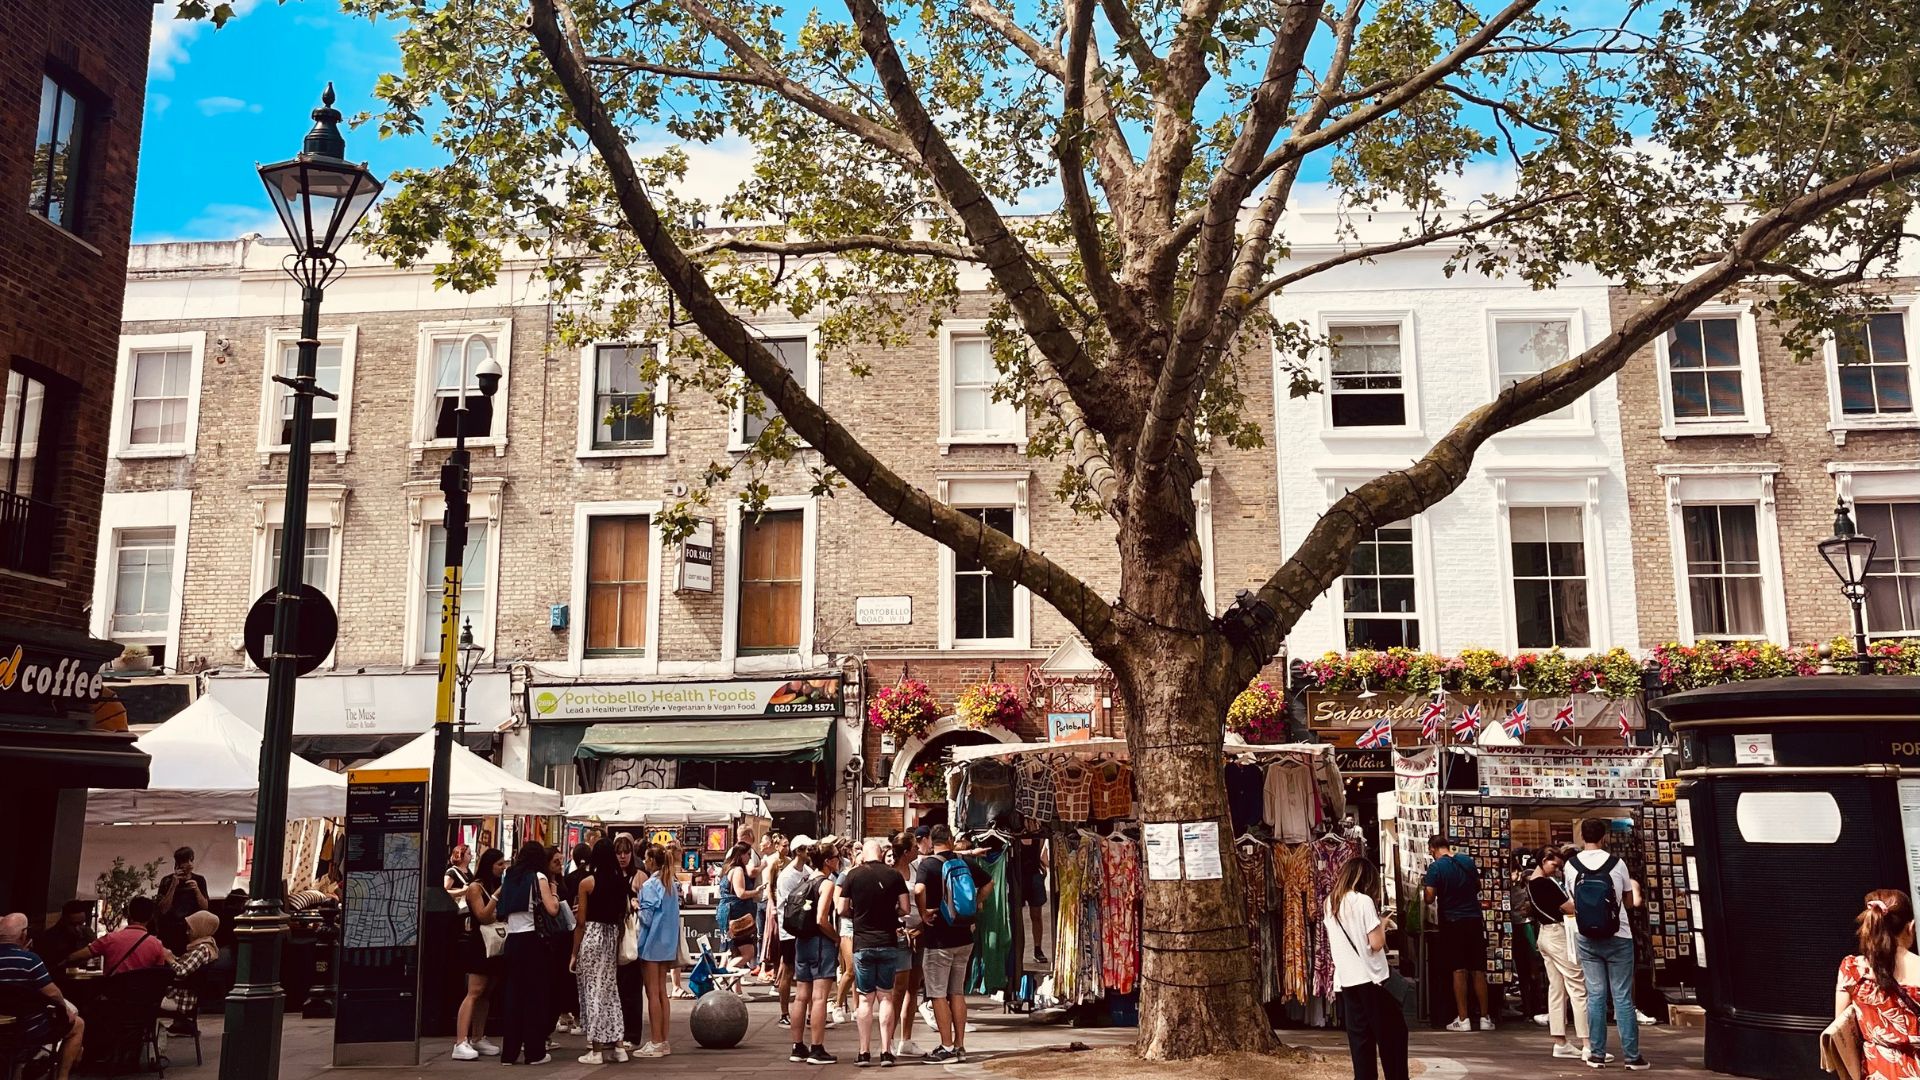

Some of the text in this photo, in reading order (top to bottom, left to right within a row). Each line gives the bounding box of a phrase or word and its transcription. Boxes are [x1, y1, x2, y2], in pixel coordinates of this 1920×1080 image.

[686, 548, 712, 560] FOR SALE
[859, 608, 910, 617] PORTOBELLO
[861, 615, 884, 623] ROAD
[21, 658, 103, 699] coffee
[565, 690, 647, 705] Portobello
[651, 689, 704, 703] Health
[709, 688, 757, 702] Foods
[565, 706, 584, 714] Lead
[592, 705, 627, 714] Healthier
[628, 704, 661, 713] Lifestyle
[667, 704, 706, 712] Vegetarian
[713, 703, 736, 712] Vegan
[774, 703, 836, 712] 020 7229 5571
[1314, 701, 1428, 725] Saporital
[345, 708, 375, 720] The Muse
[1055, 718, 1089, 736] Portobello
[1486, 745, 1653, 756] WOODEN FRIDGE MAGNETS
[1336, 753, 1386, 769] Italian
